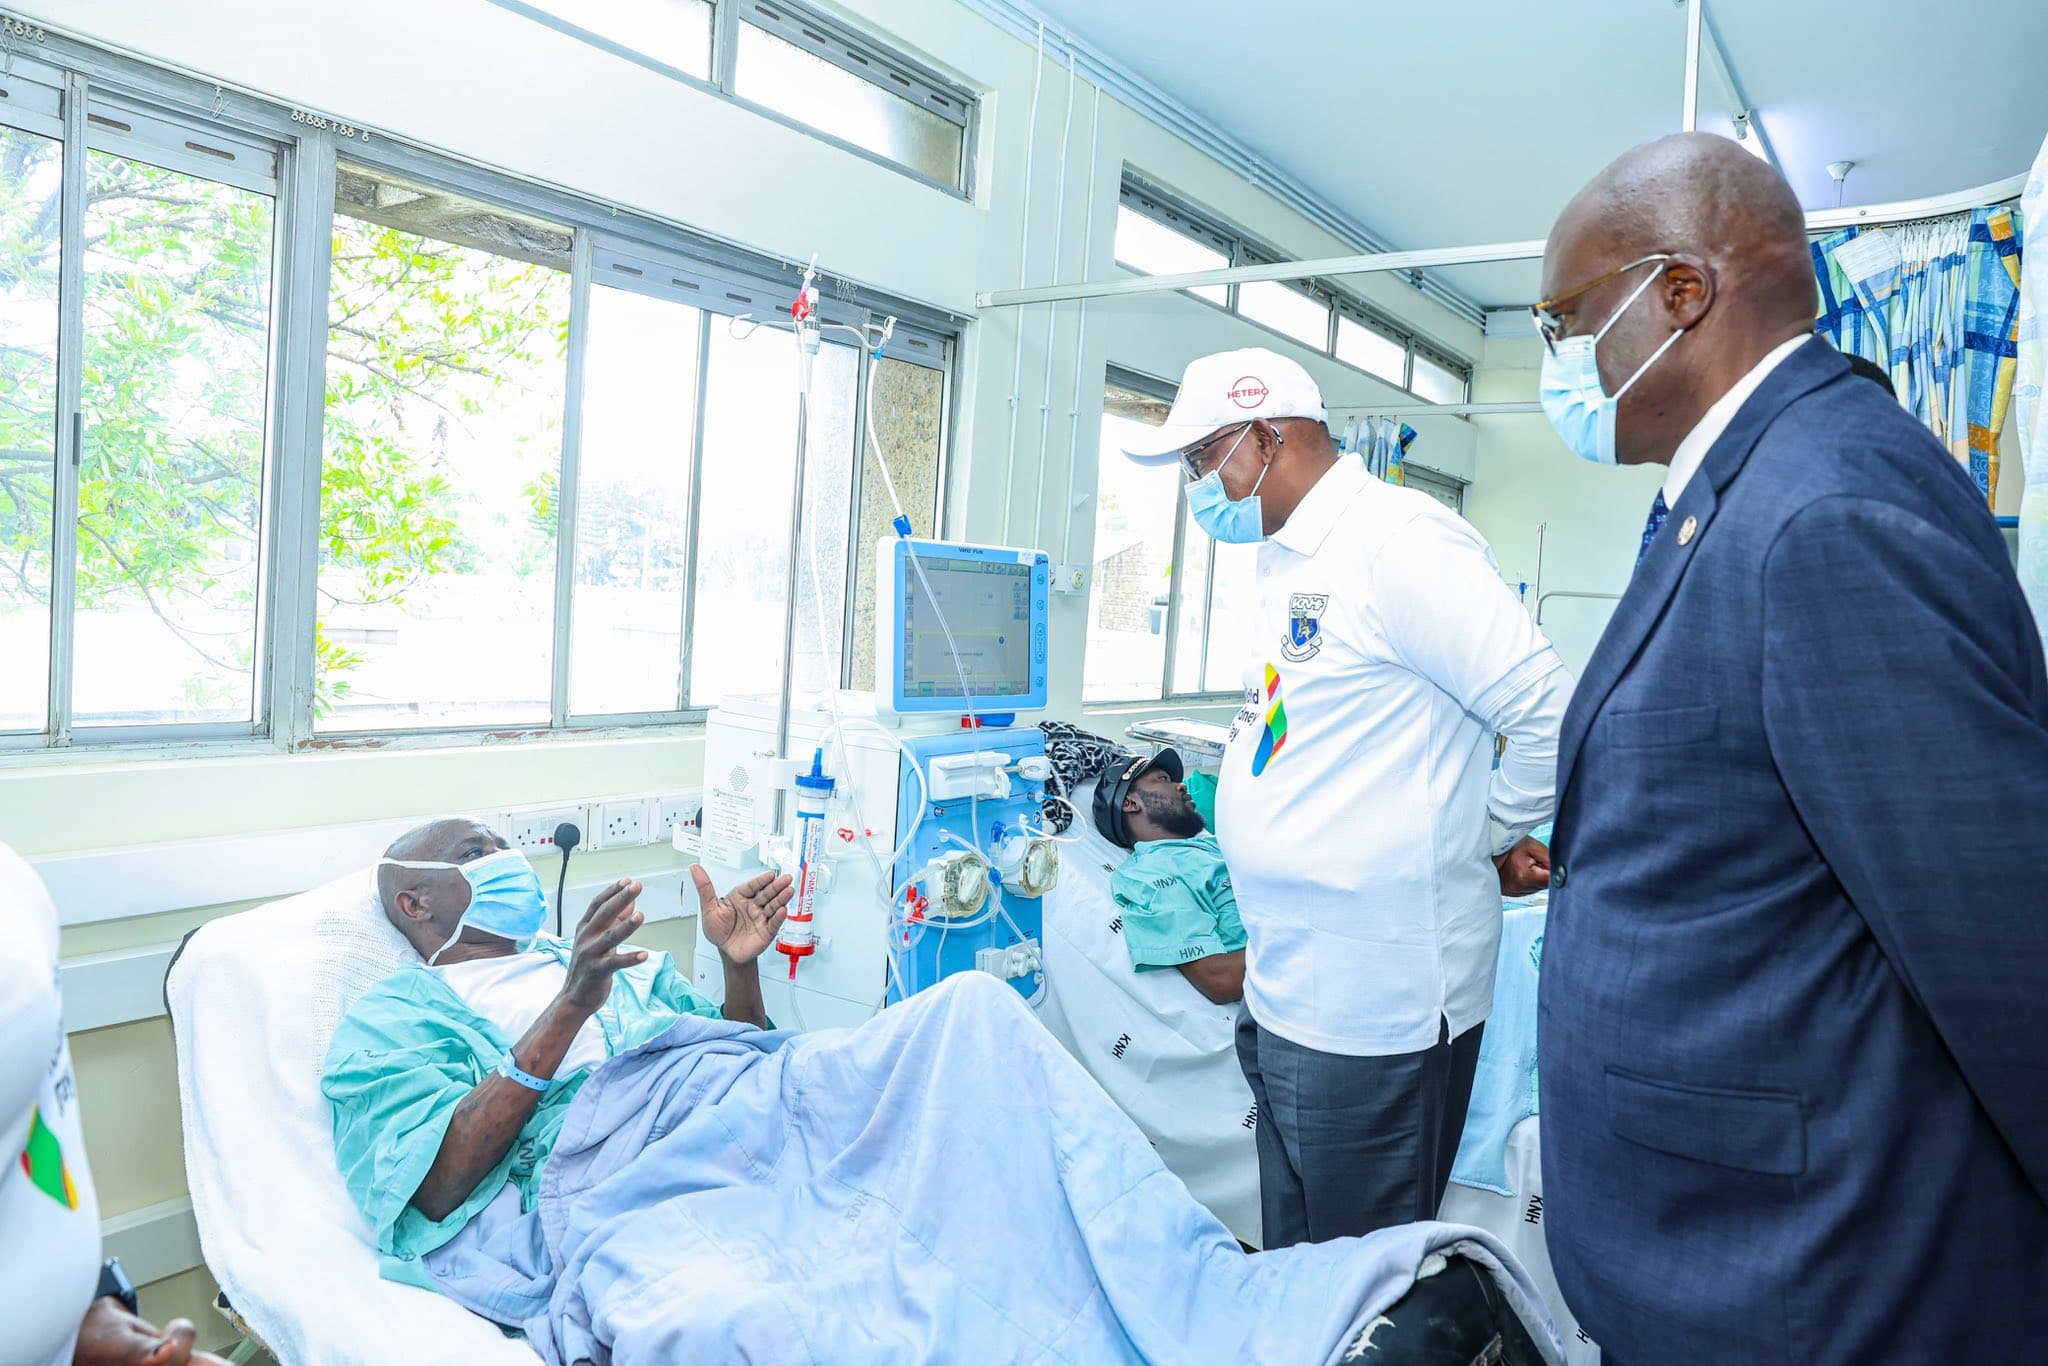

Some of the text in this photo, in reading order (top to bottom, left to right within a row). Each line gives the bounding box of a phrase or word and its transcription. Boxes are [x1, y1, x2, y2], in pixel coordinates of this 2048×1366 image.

[1227, 387, 1269, 399] HETERO
[1291, 596, 1325, 611] KNH
[1153, 877, 1178, 889] KNH
[1109, 915, 1123, 934] NH
[1111, 1033, 1132, 1060] KNH
[1525, 1195, 1544, 1224] KNH
